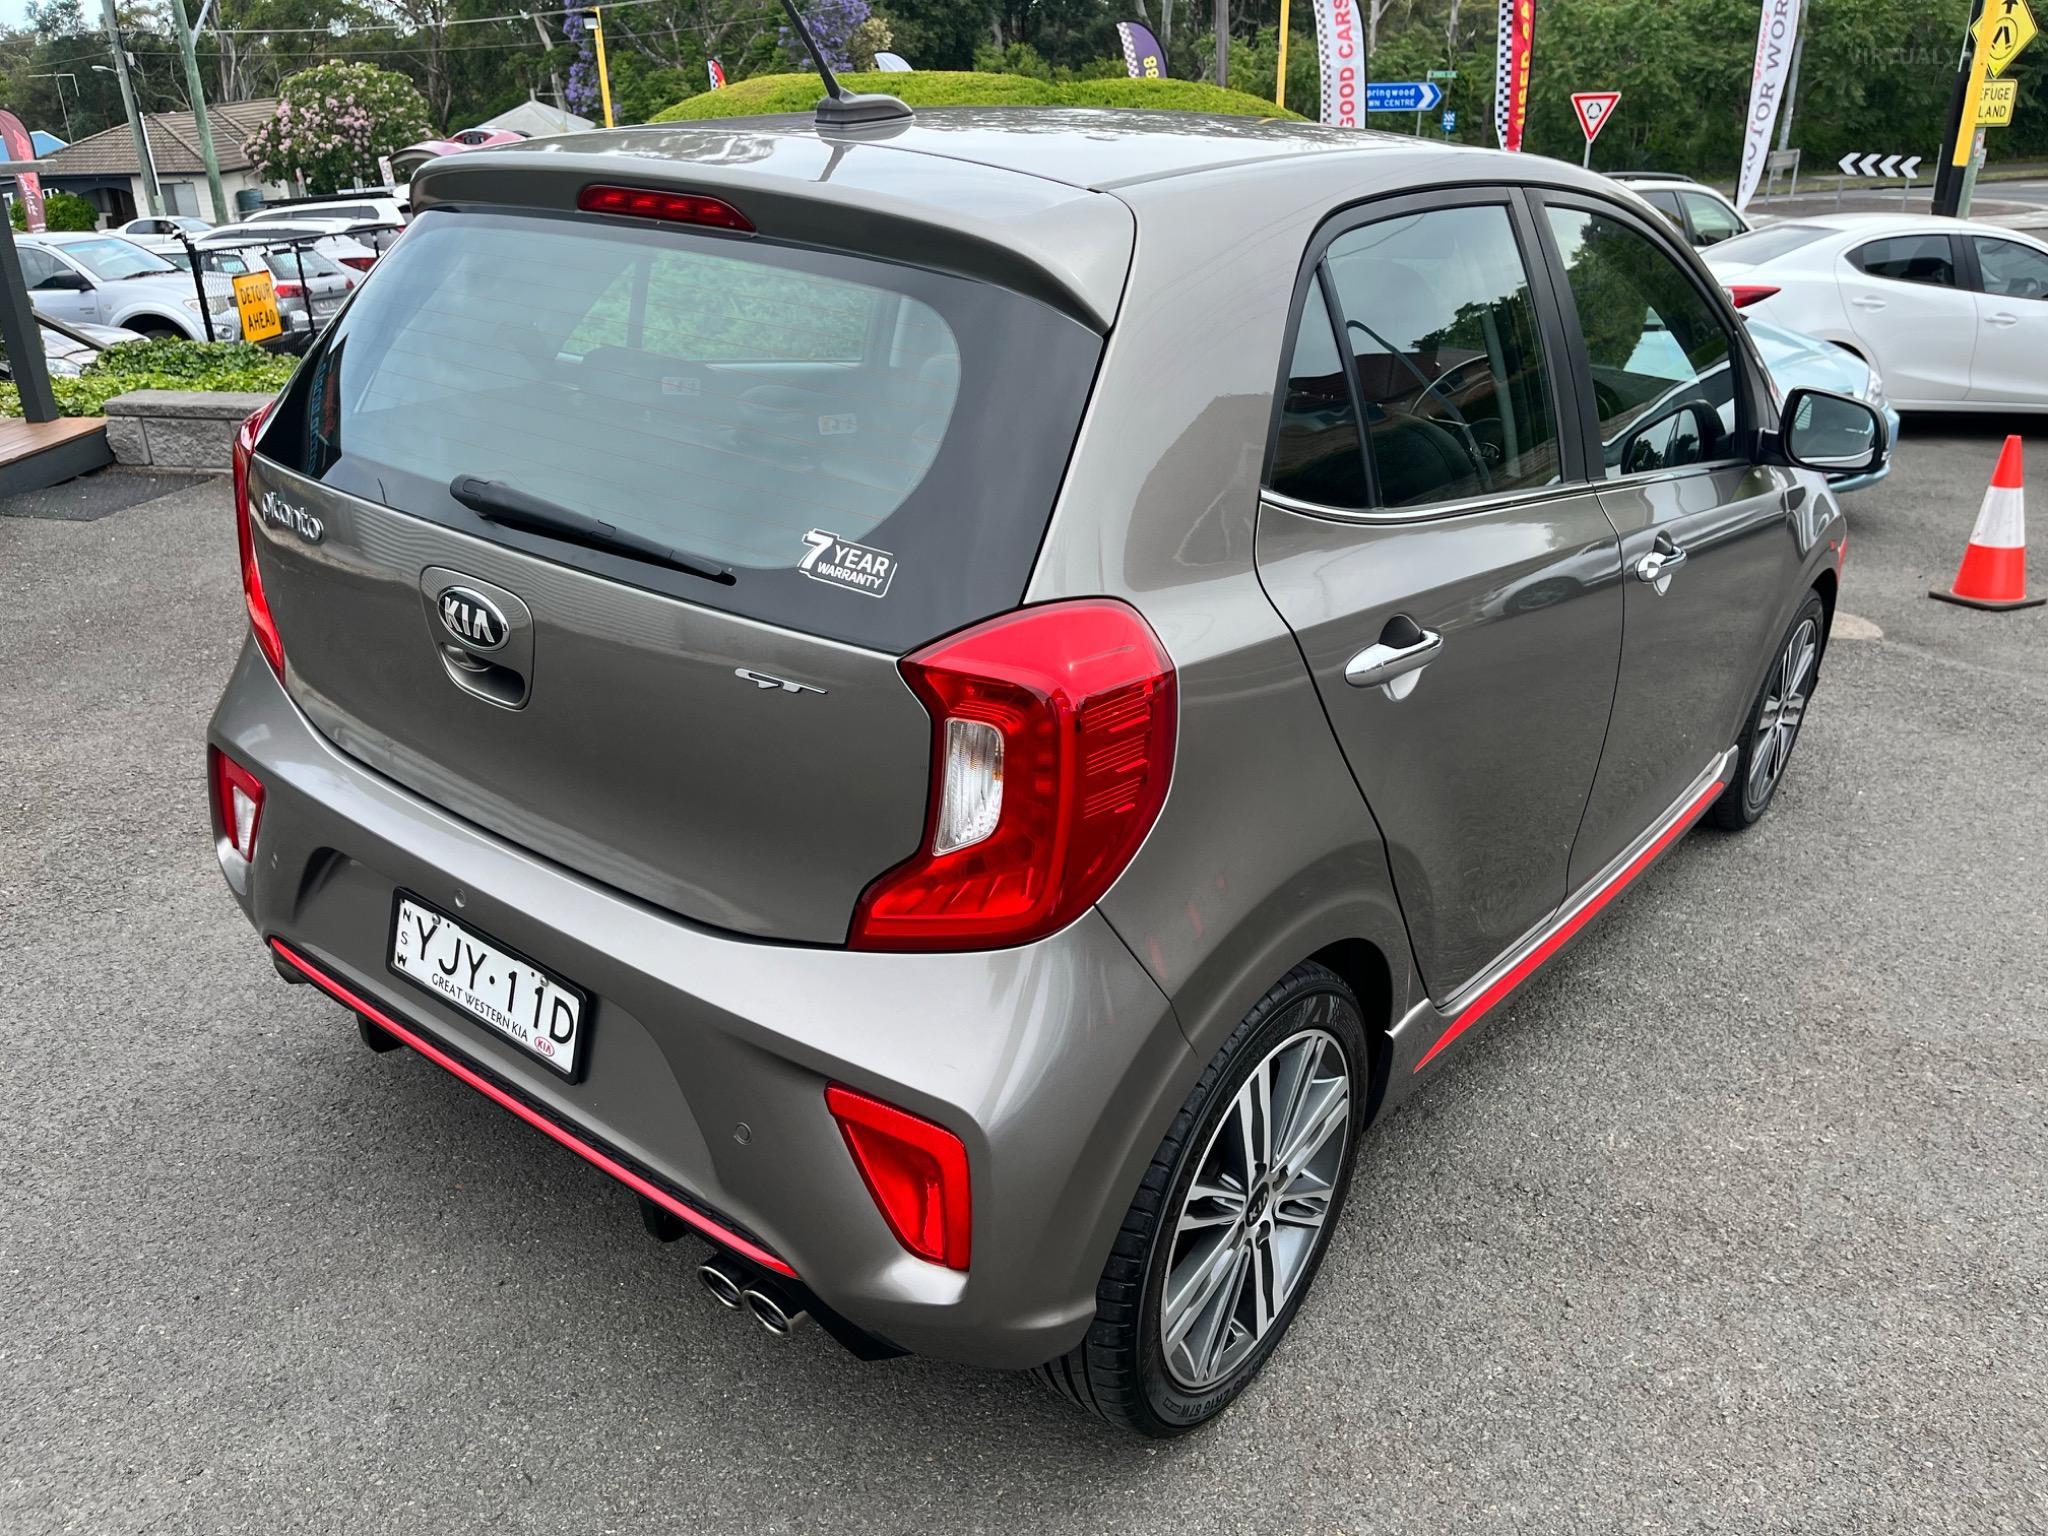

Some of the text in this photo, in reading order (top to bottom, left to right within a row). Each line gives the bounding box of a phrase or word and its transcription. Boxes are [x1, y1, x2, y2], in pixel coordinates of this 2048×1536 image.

[1333, 0, 1355, 128] GOOD CARS
[1384, 99, 1415, 107] CENTRE
[240, 282, 272, 305] DETOUR
[248, 309, 276, 332] AHEAD
[801, 529, 890, 577] 7 YEAR
[817, 561, 884, 589] WARRANTY
[443, 595, 496, 645] KIA
[432, 973, 528, 1042] GREAT WESTERN KIA
[536, 1037, 554, 1056] KIA
[1249, 1191, 1270, 1223] KIA
